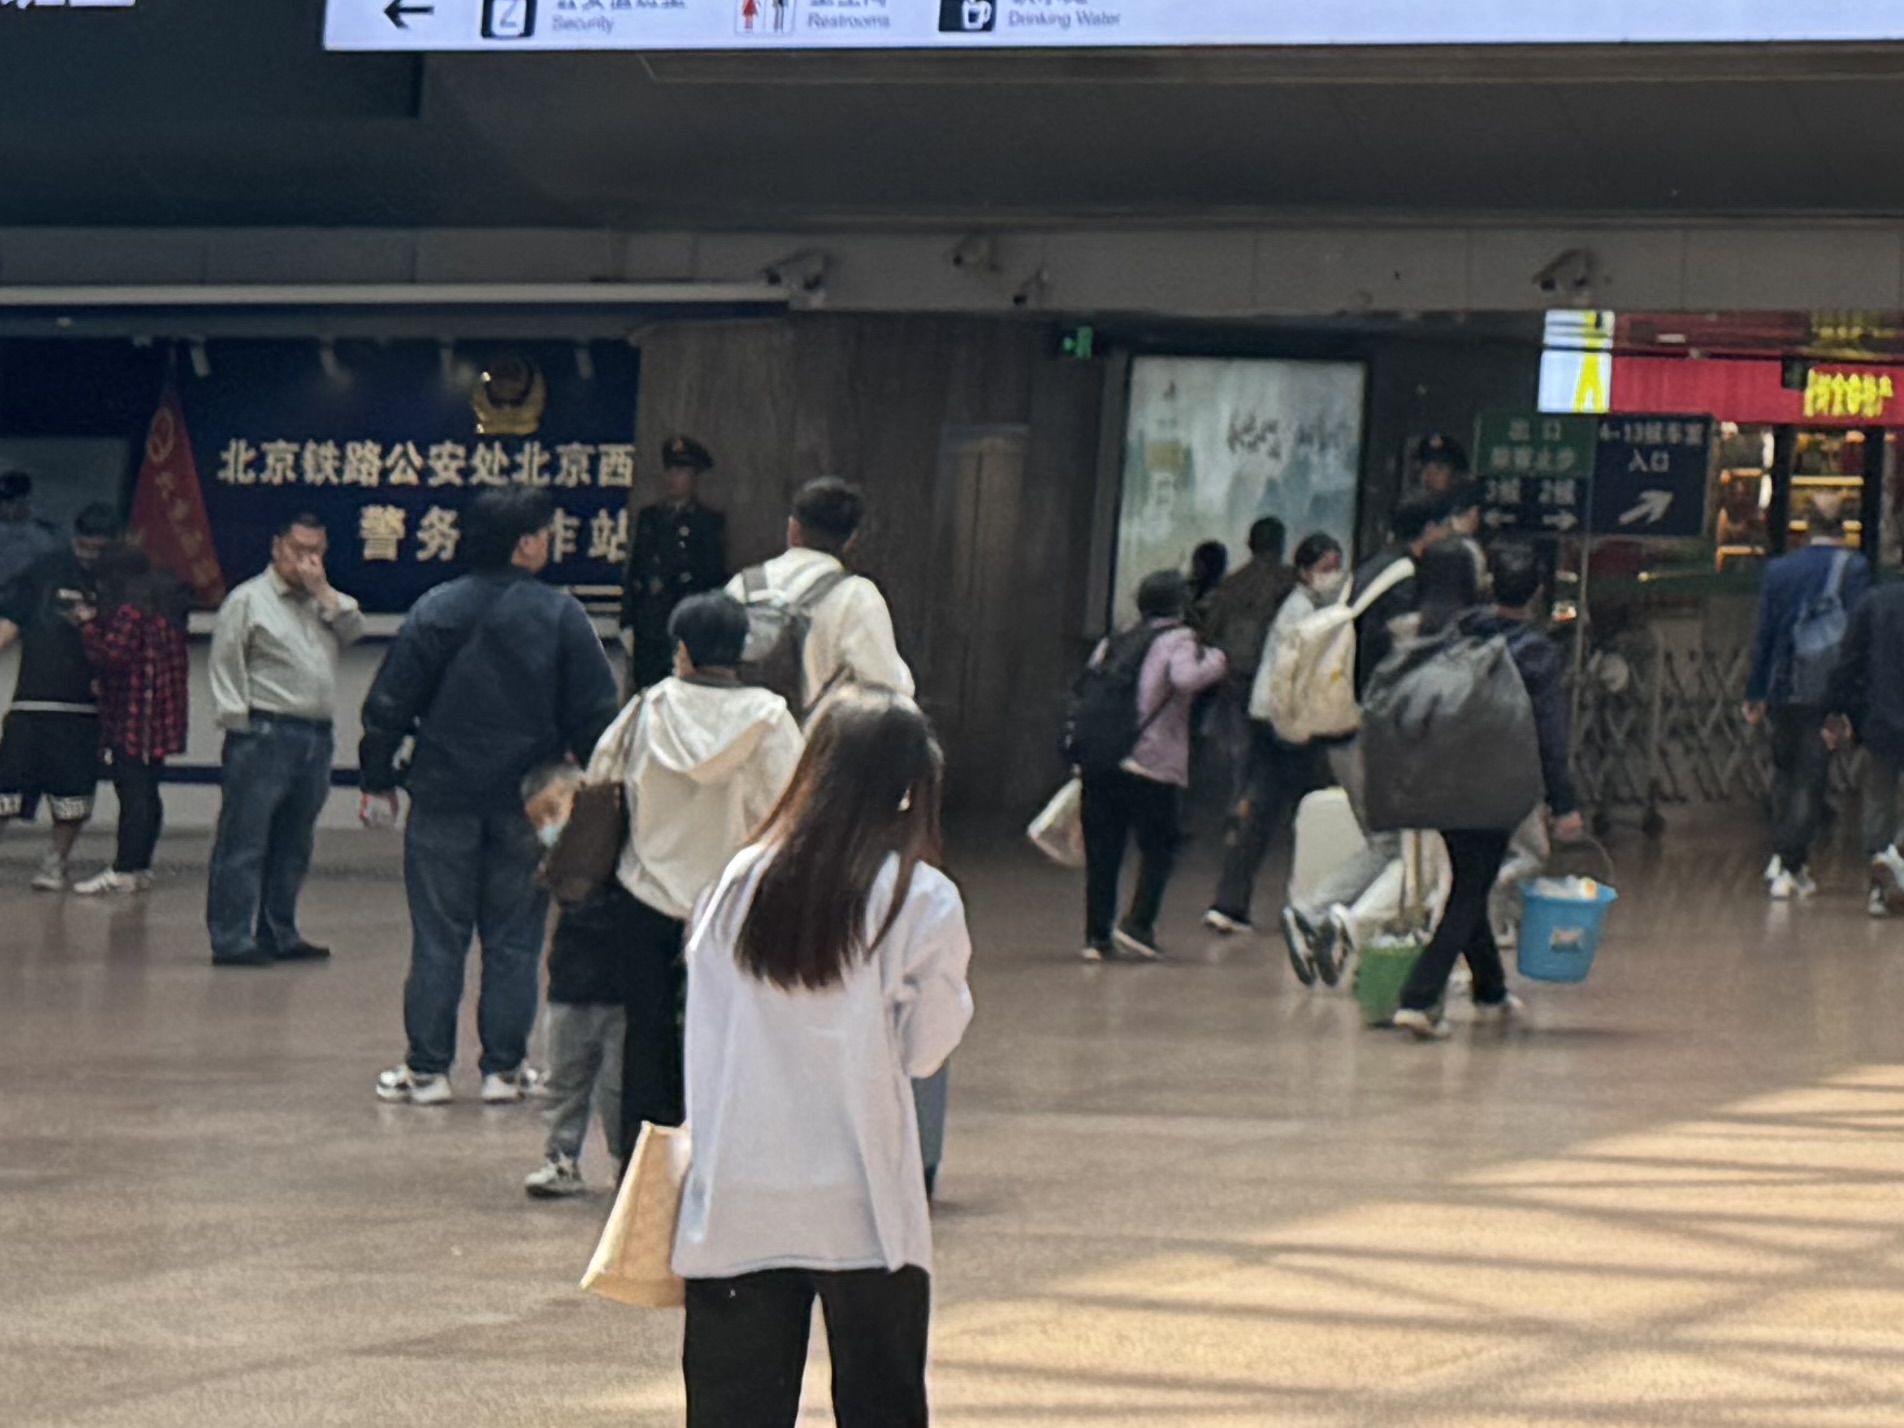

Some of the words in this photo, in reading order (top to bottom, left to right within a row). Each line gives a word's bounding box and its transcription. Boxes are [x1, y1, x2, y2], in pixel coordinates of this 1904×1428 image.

[552, 16, 614, 34] Security
[807, 13, 891, 28] Restrooms
[1009, 10, 1082, 30] Drinking
[1084, 11, 1120, 26] Water
[218, 440, 636, 488] 北京铁路公安处北京西
